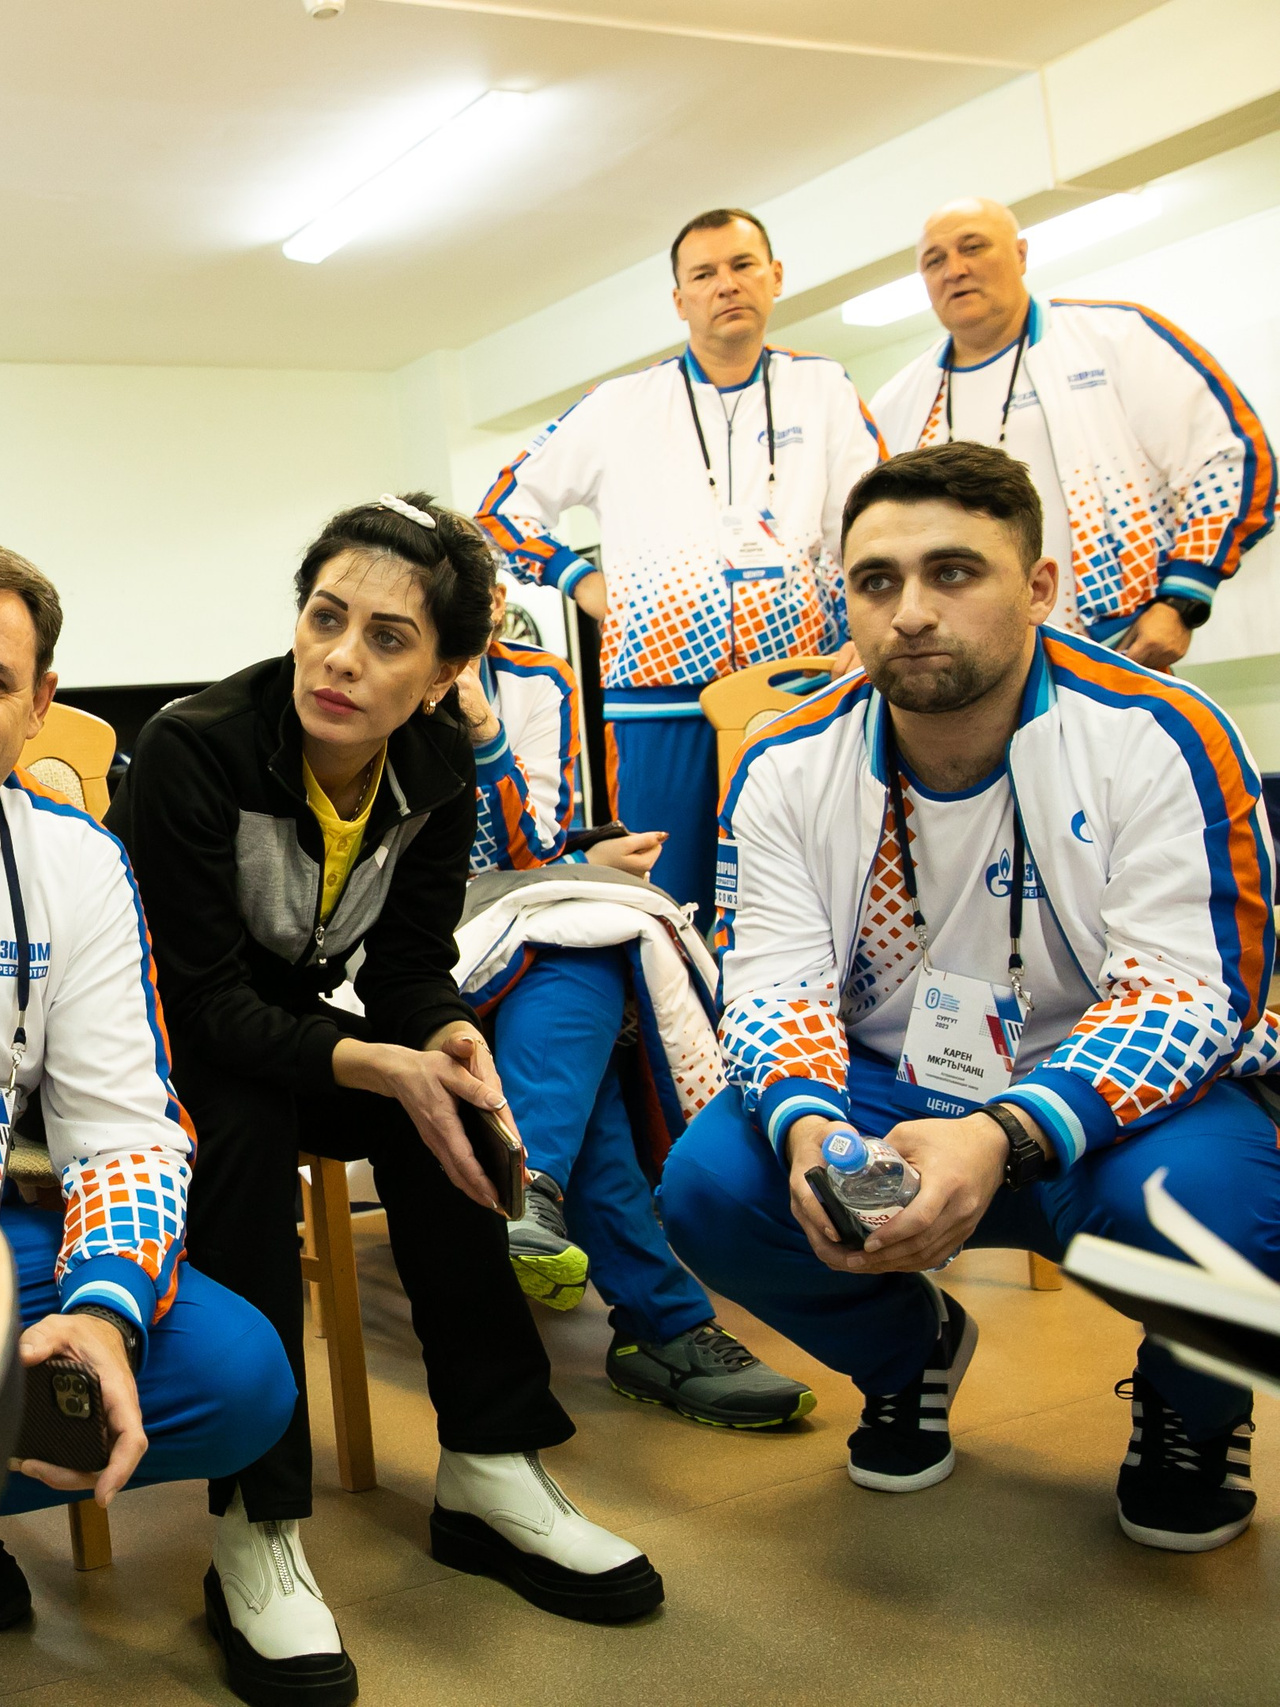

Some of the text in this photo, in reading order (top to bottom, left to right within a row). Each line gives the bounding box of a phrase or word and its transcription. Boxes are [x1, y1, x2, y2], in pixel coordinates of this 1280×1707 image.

[716, 892, 738, 905] СОЮЗ
[934, 1021, 949, 1030] 2023
[936, 1014, 958, 1025] СУРГУТ
[943, 1047, 972, 1062] КАРЕН
[926, 1055, 984, 1078] МКРТЫЧАНЦ
[926, 1097, 965, 1116] ЦЕНТР
